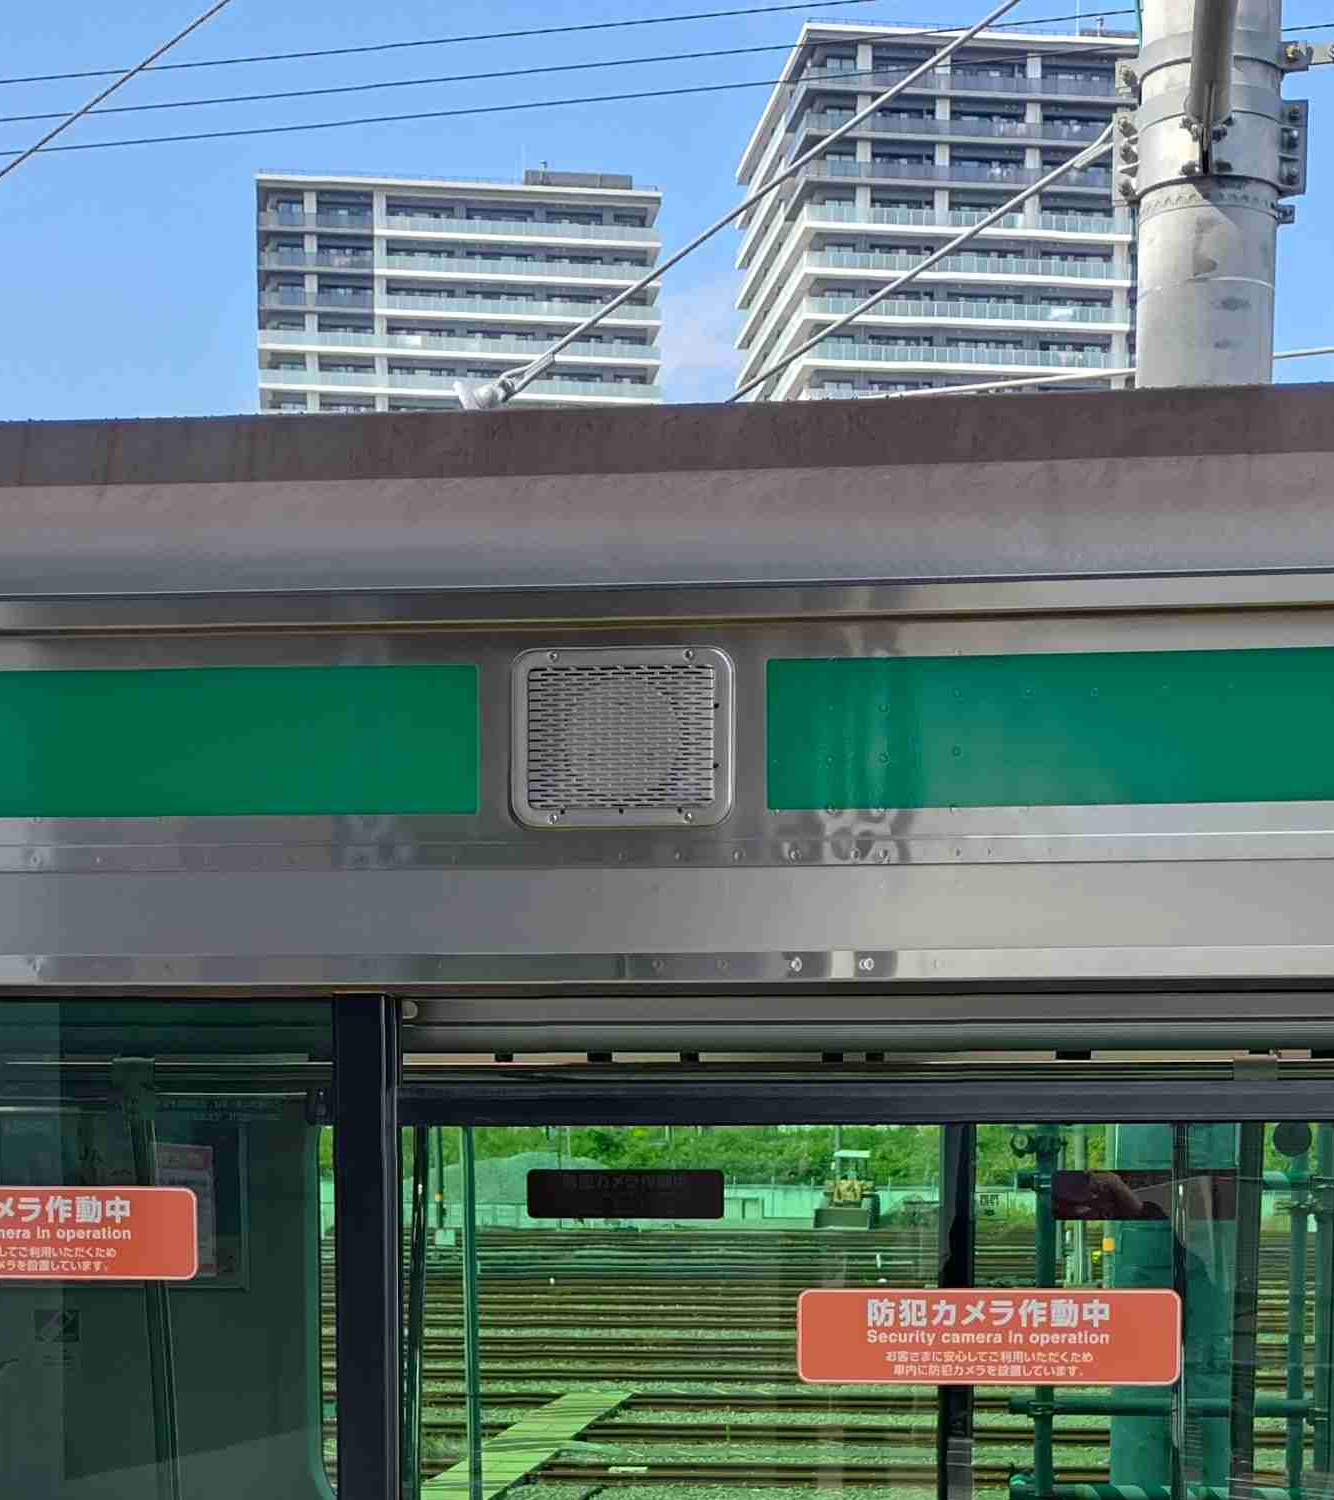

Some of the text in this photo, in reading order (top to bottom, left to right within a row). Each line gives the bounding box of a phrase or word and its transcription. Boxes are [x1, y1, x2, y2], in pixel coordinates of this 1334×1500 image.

[56, 1226, 132, 1243] operation
[866, 1299, 1111, 1328] 防犯カメラ作動中
[867, 1330, 936, 1346] Security
[941, 1331, 1004, 1345] camera
[1029, 1331, 1110, 1347] operation
